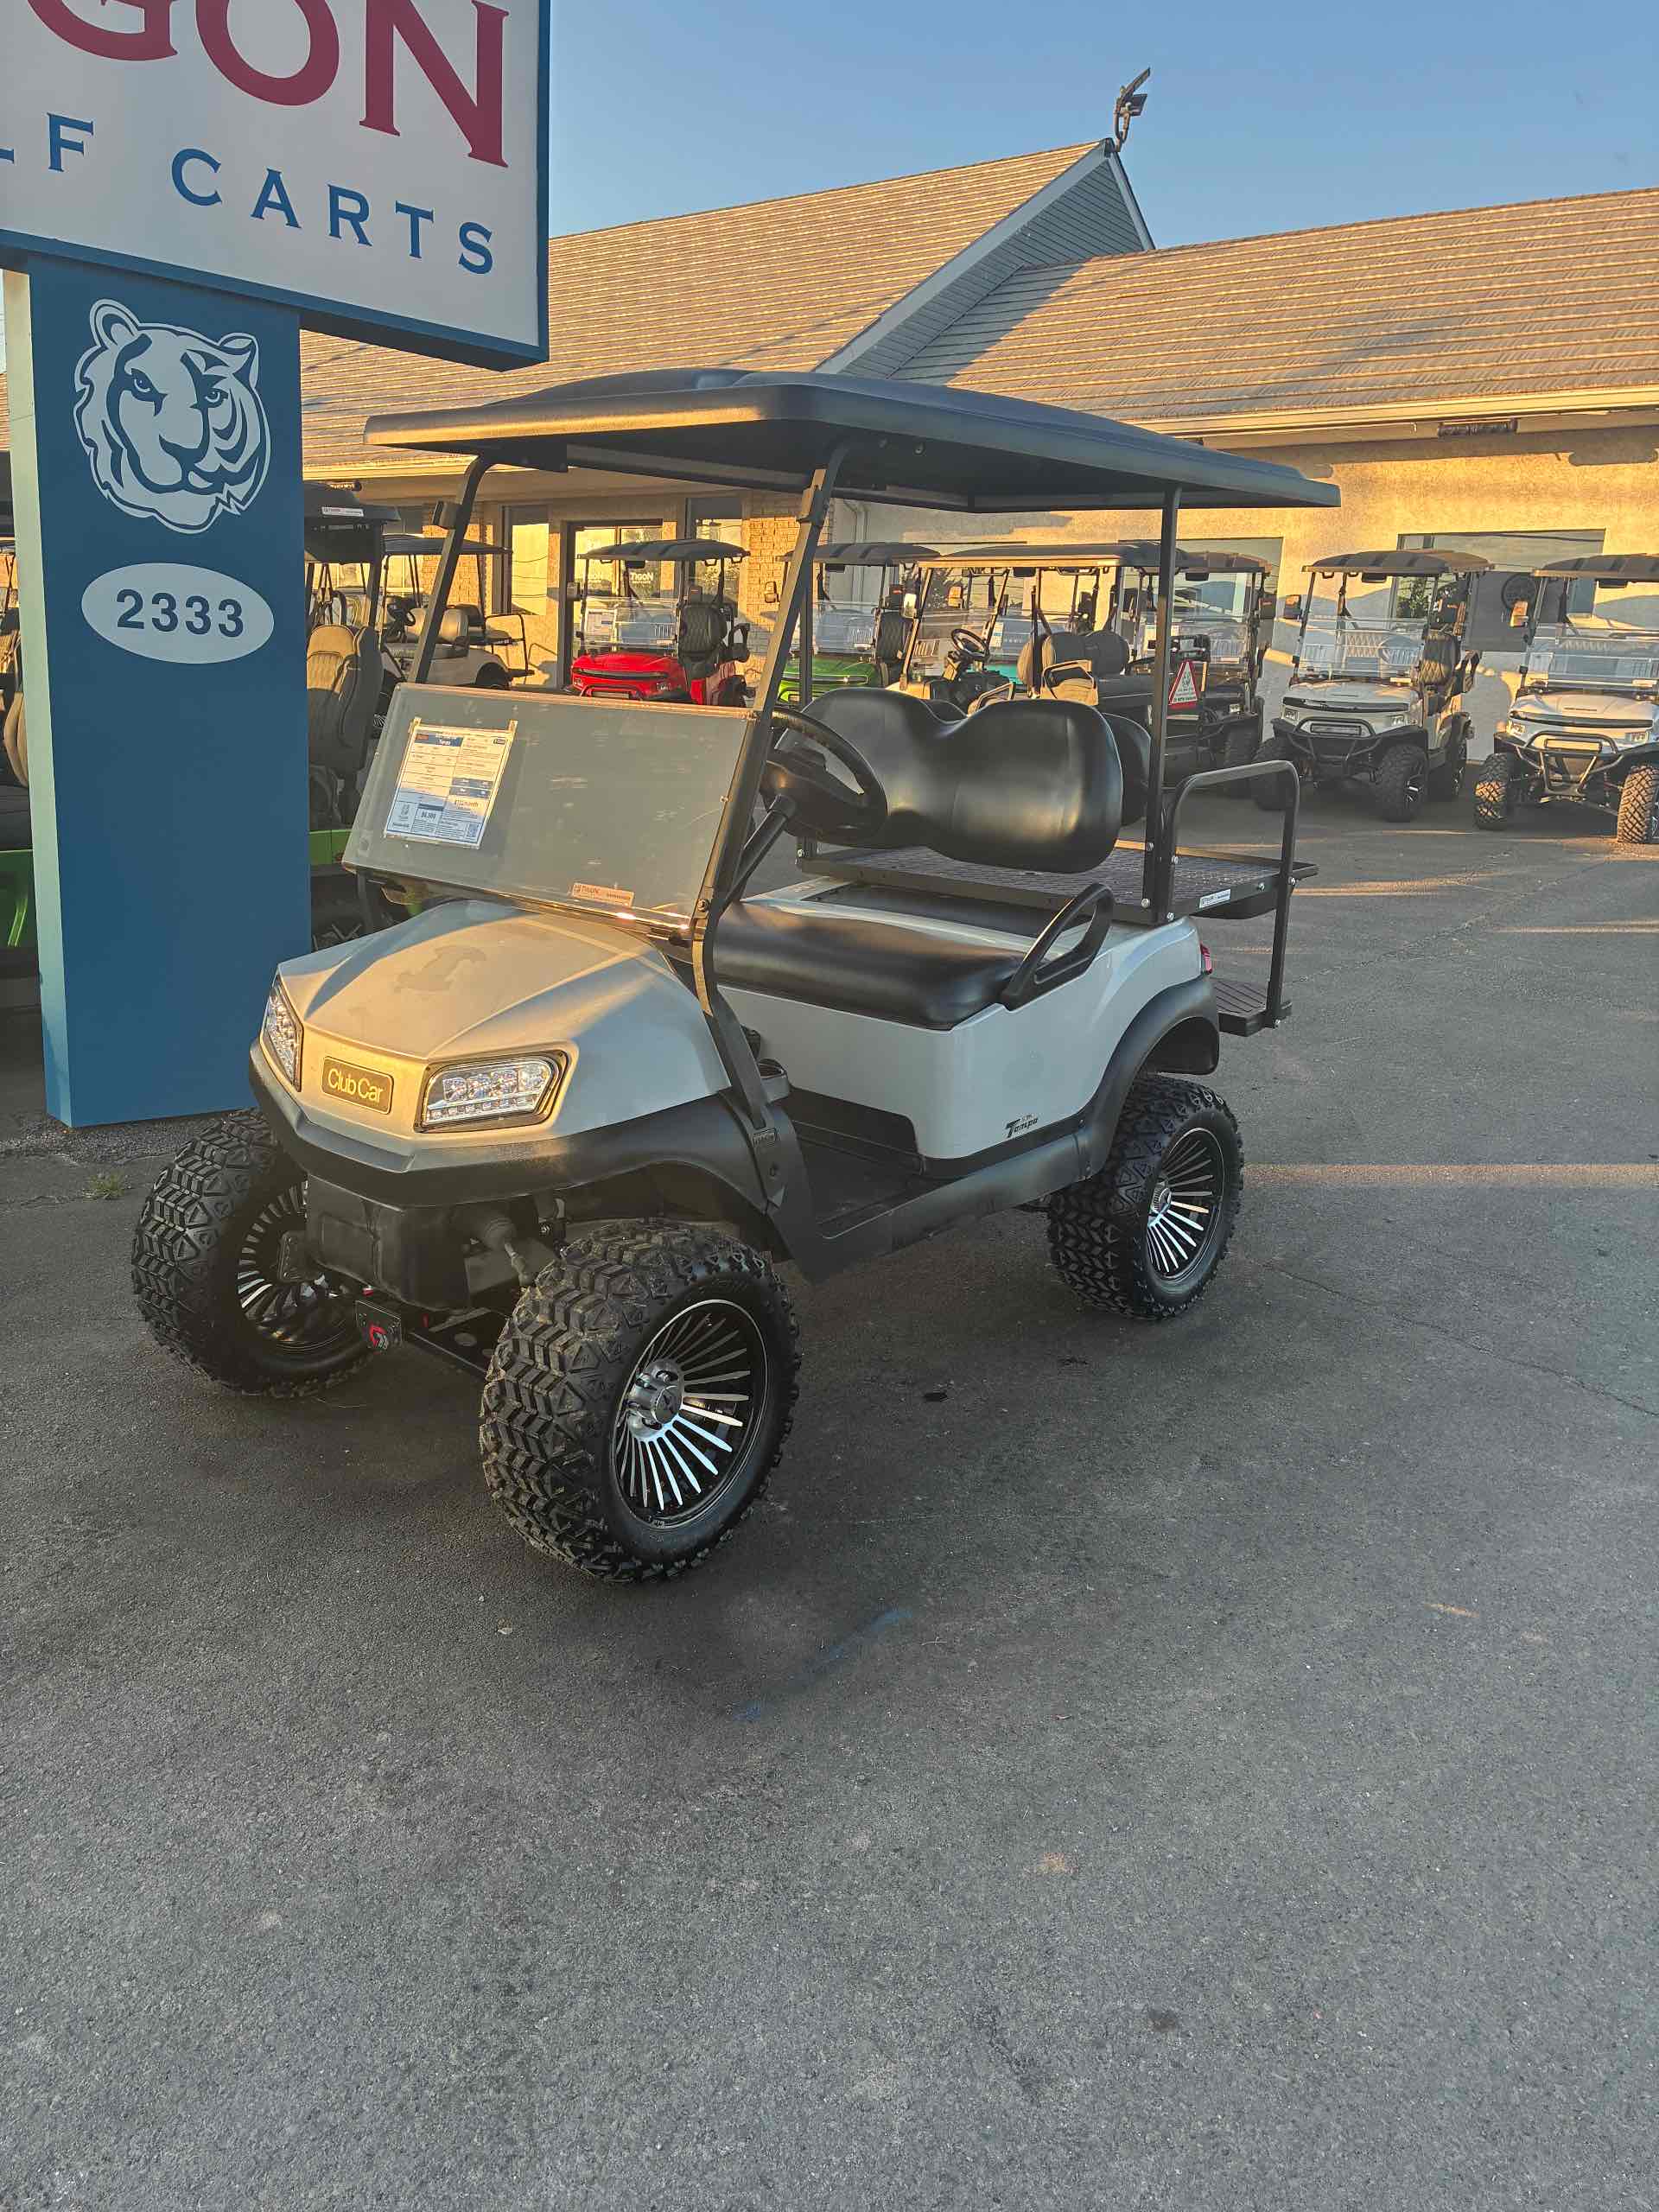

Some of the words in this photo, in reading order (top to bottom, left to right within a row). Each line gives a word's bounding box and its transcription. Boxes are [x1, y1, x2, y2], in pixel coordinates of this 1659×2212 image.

[171, 148, 493, 275] CARTS
[116, 588, 244, 638] 2333
[327, 1068, 357, 1095] Club
[358, 1077, 384, 1103] Car
